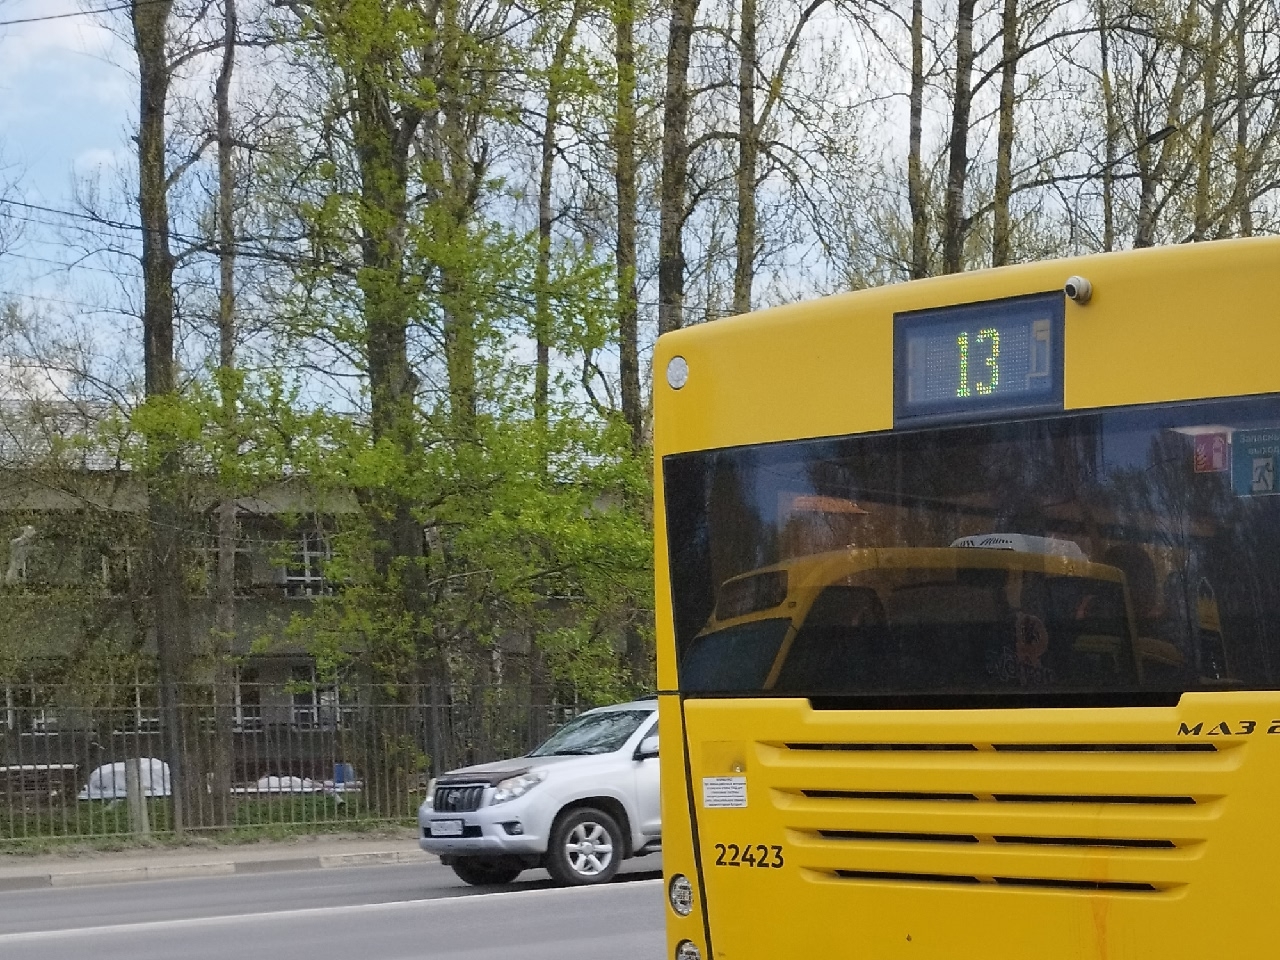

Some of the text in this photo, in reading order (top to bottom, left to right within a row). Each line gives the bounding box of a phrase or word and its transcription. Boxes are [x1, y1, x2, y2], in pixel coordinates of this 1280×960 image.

[957, 328, 1000, 397] 13
[1248, 446, 1280, 456] выход
[1177, 720, 1257, 736] МАЗ
[714, 843, 784, 868] 22423
